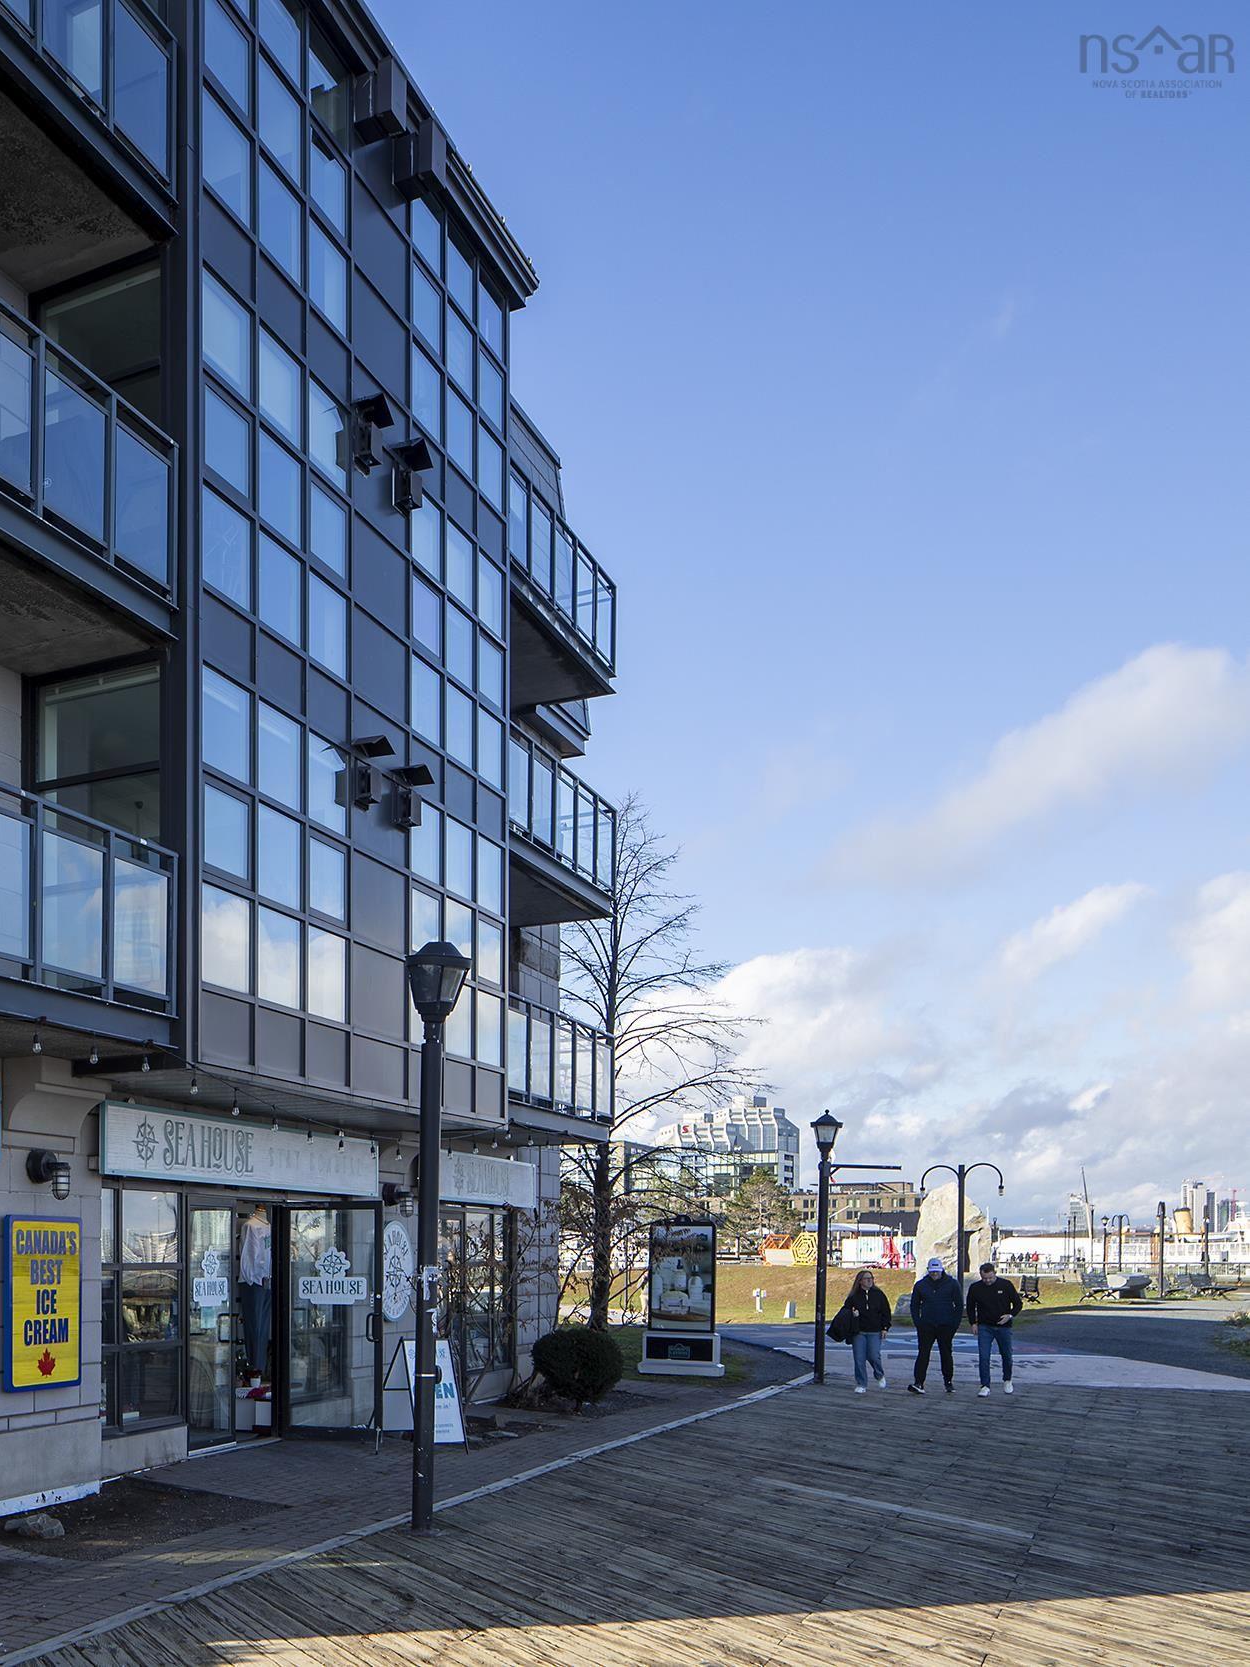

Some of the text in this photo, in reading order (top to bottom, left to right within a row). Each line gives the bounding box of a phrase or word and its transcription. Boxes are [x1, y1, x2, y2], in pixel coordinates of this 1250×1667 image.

[15, 1229, 77, 1256] CANADA'S
[30, 1258, 63, 1285] BEST
[302, 1280, 364, 1295] SEA HOUSE
[36, 1289, 57, 1315] ICE
[23, 1318, 69, 1347] CREAM
